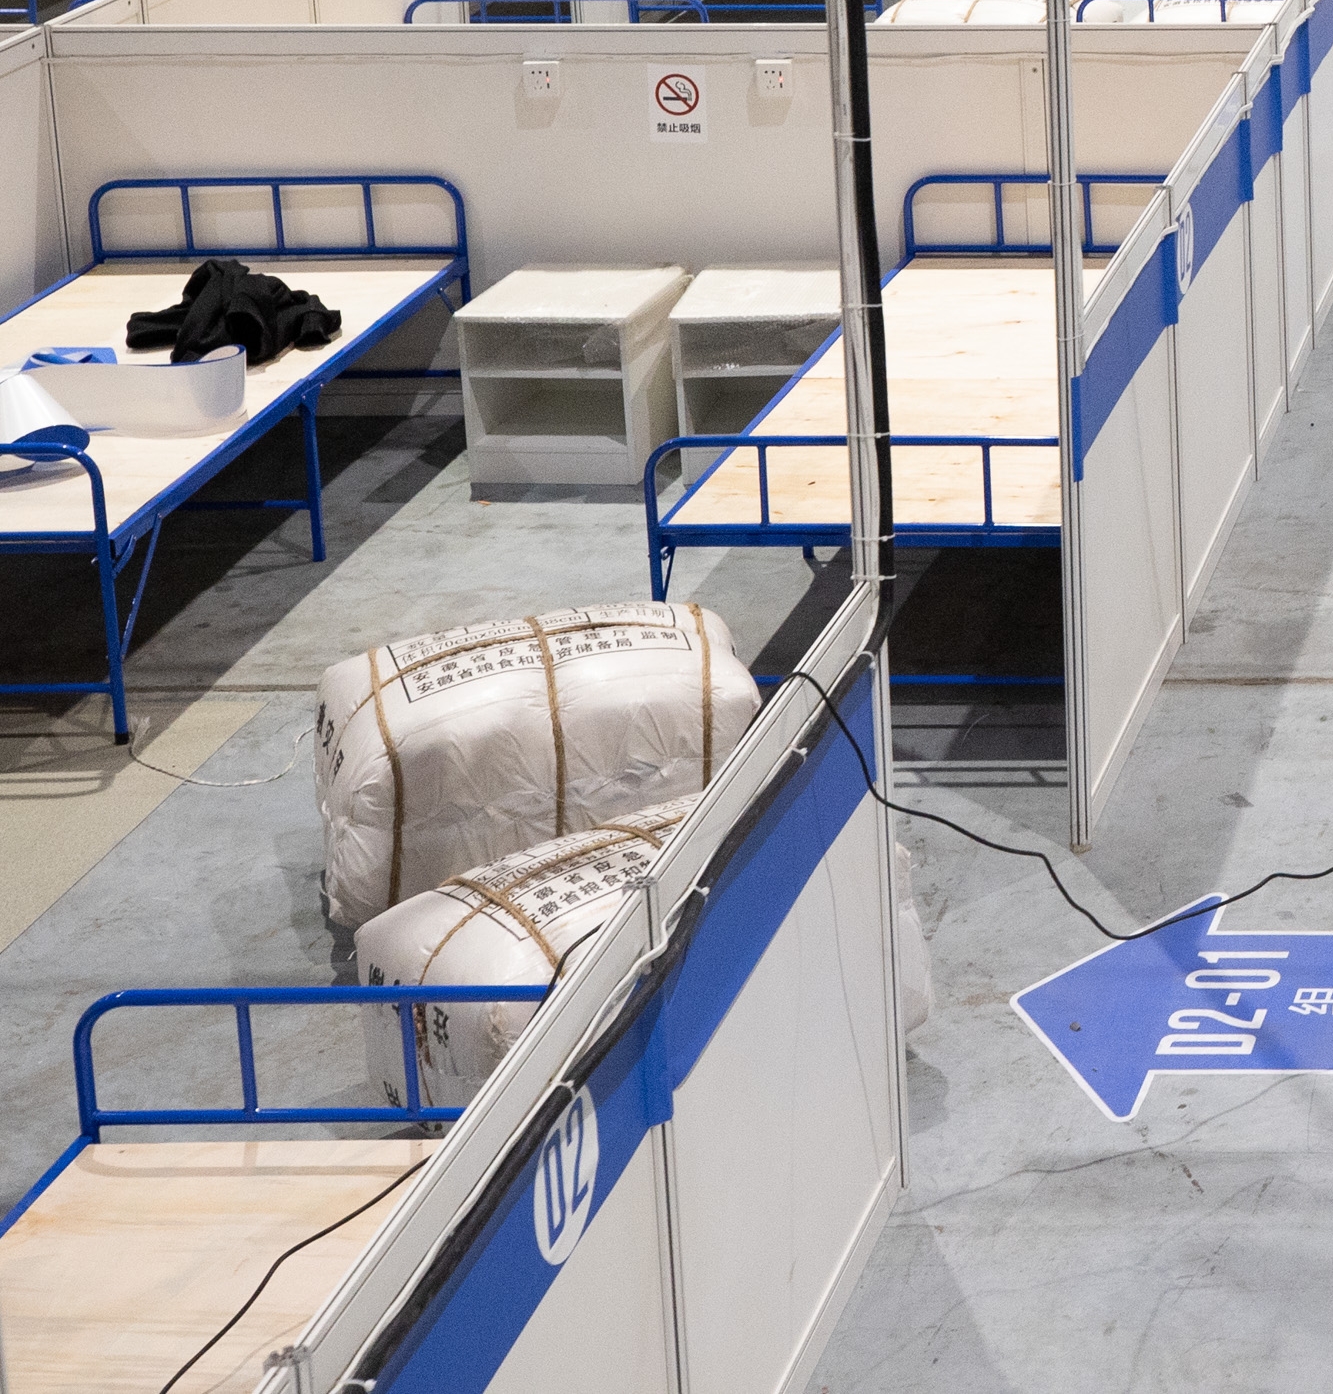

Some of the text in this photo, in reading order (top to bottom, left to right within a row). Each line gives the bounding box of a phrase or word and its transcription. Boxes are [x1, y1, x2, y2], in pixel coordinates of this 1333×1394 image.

[657, 123, 702, 134] 禁止吸烟
[1154, 950, 1290, 1055] D2-01
[542, 1094, 590, 1250] D2
